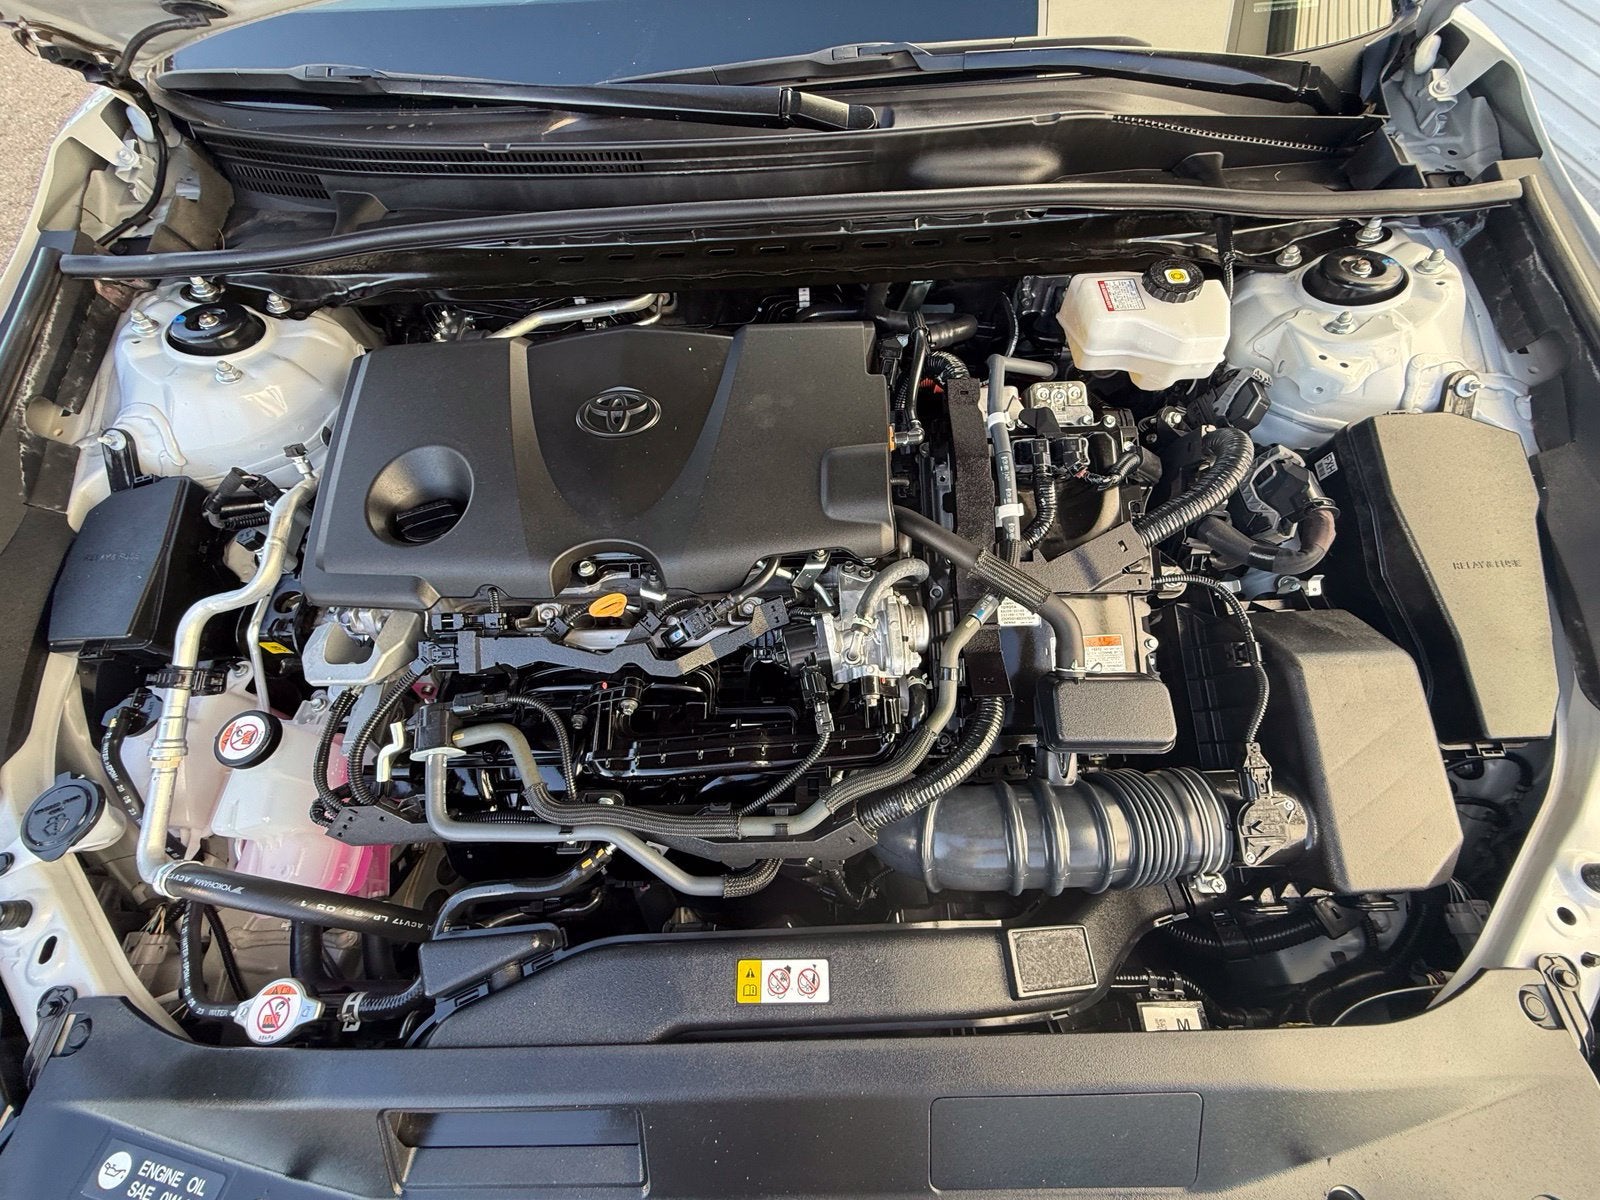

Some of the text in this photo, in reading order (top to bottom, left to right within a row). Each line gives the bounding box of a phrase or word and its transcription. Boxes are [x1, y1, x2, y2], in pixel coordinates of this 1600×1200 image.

[194, 878, 232, 892] YOKOHAMA
[373, 914, 389, 923] LP
[392, 917, 424, 929] ACV17
[1176, 1018, 1191, 1030] M
[138, 1160, 206, 1197] ENGINE OIL
[127, 1181, 156, 1200] SAE
